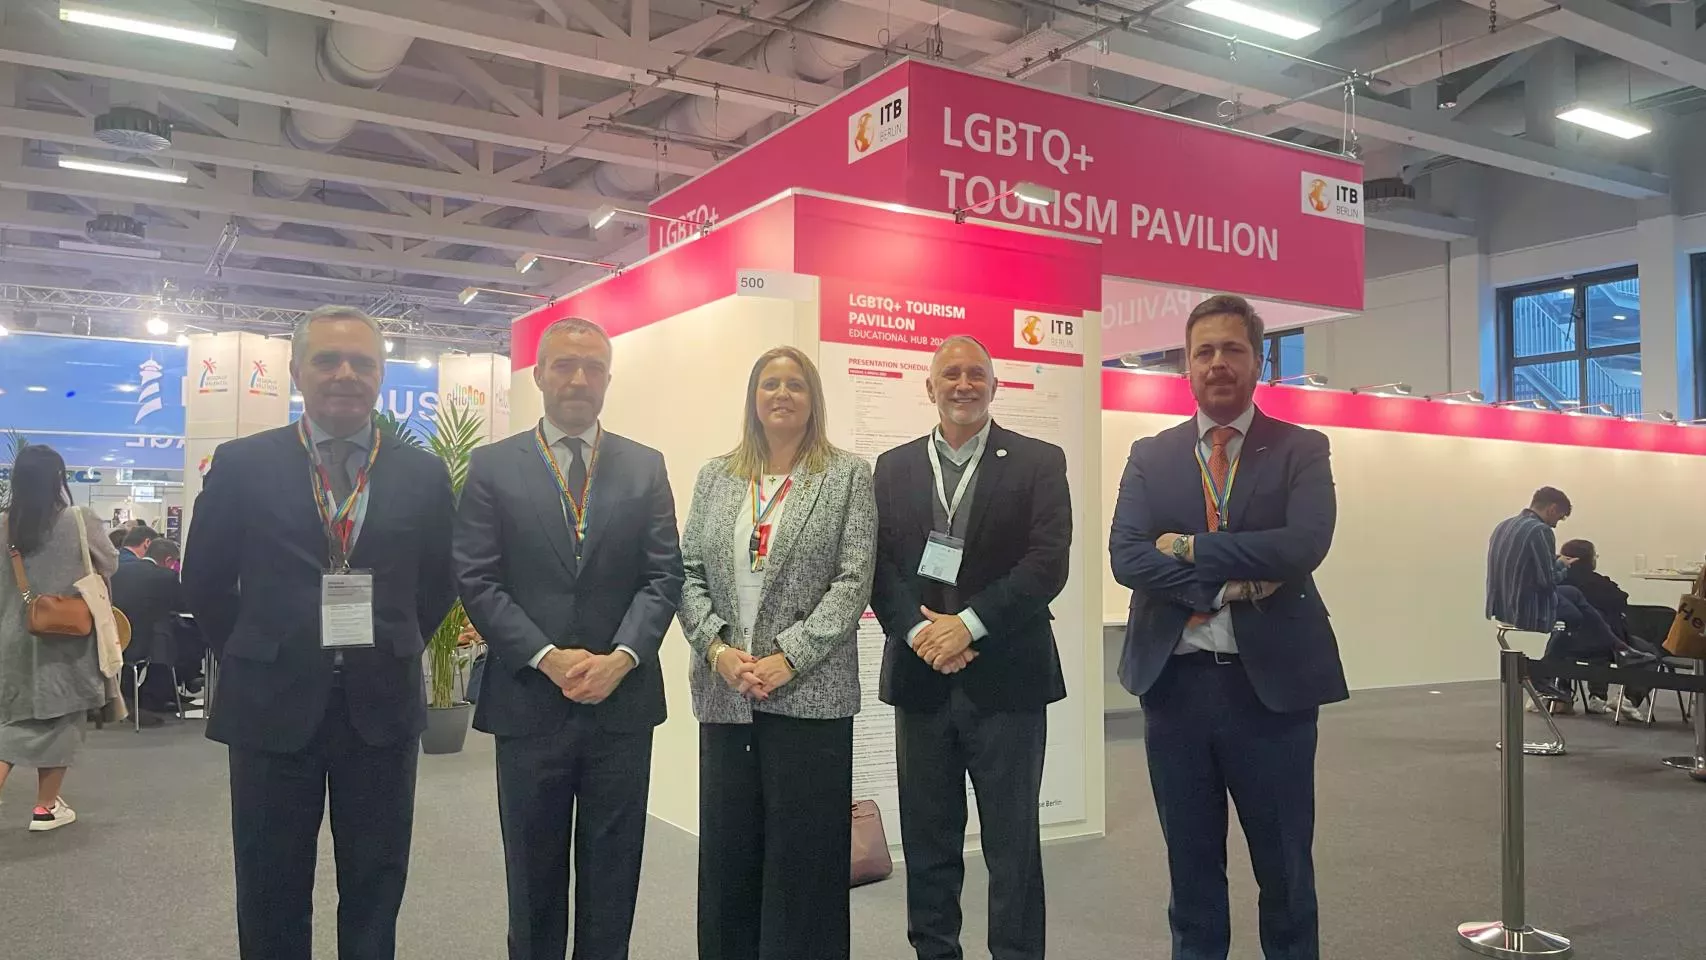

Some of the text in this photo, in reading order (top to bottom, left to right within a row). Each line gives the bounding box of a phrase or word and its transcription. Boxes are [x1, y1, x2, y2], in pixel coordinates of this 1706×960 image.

[880, 98, 902, 126] ITB
[880, 124, 902, 143] BERLIN
[943, 106, 1094, 175] LGBTQ+
[1336, 184, 1358, 204] ITB
[939, 169, 1278, 261] TOURISM PAVILION
[1336, 204, 1359, 219] BERLIN
[658, 204, 719, 251] LGBTQ+
[740, 277, 764, 289] 500
[848, 292, 966, 320] LGBTQ+ TOURISM
[848, 311, 916, 332] PAVILLON
[1051, 319, 1074, 336] ITB
[848, 328, 944, 347] EDUCATIONAL HUB 202
[1051, 337, 1074, 349] BERLIN
[848, 357, 930, 372] PRESENTATION SCHEDUL
[446, 383, 486, 406] CHICAGO
[1679, 602, 1706, 630] He
[743, 627, 749, 636] E
